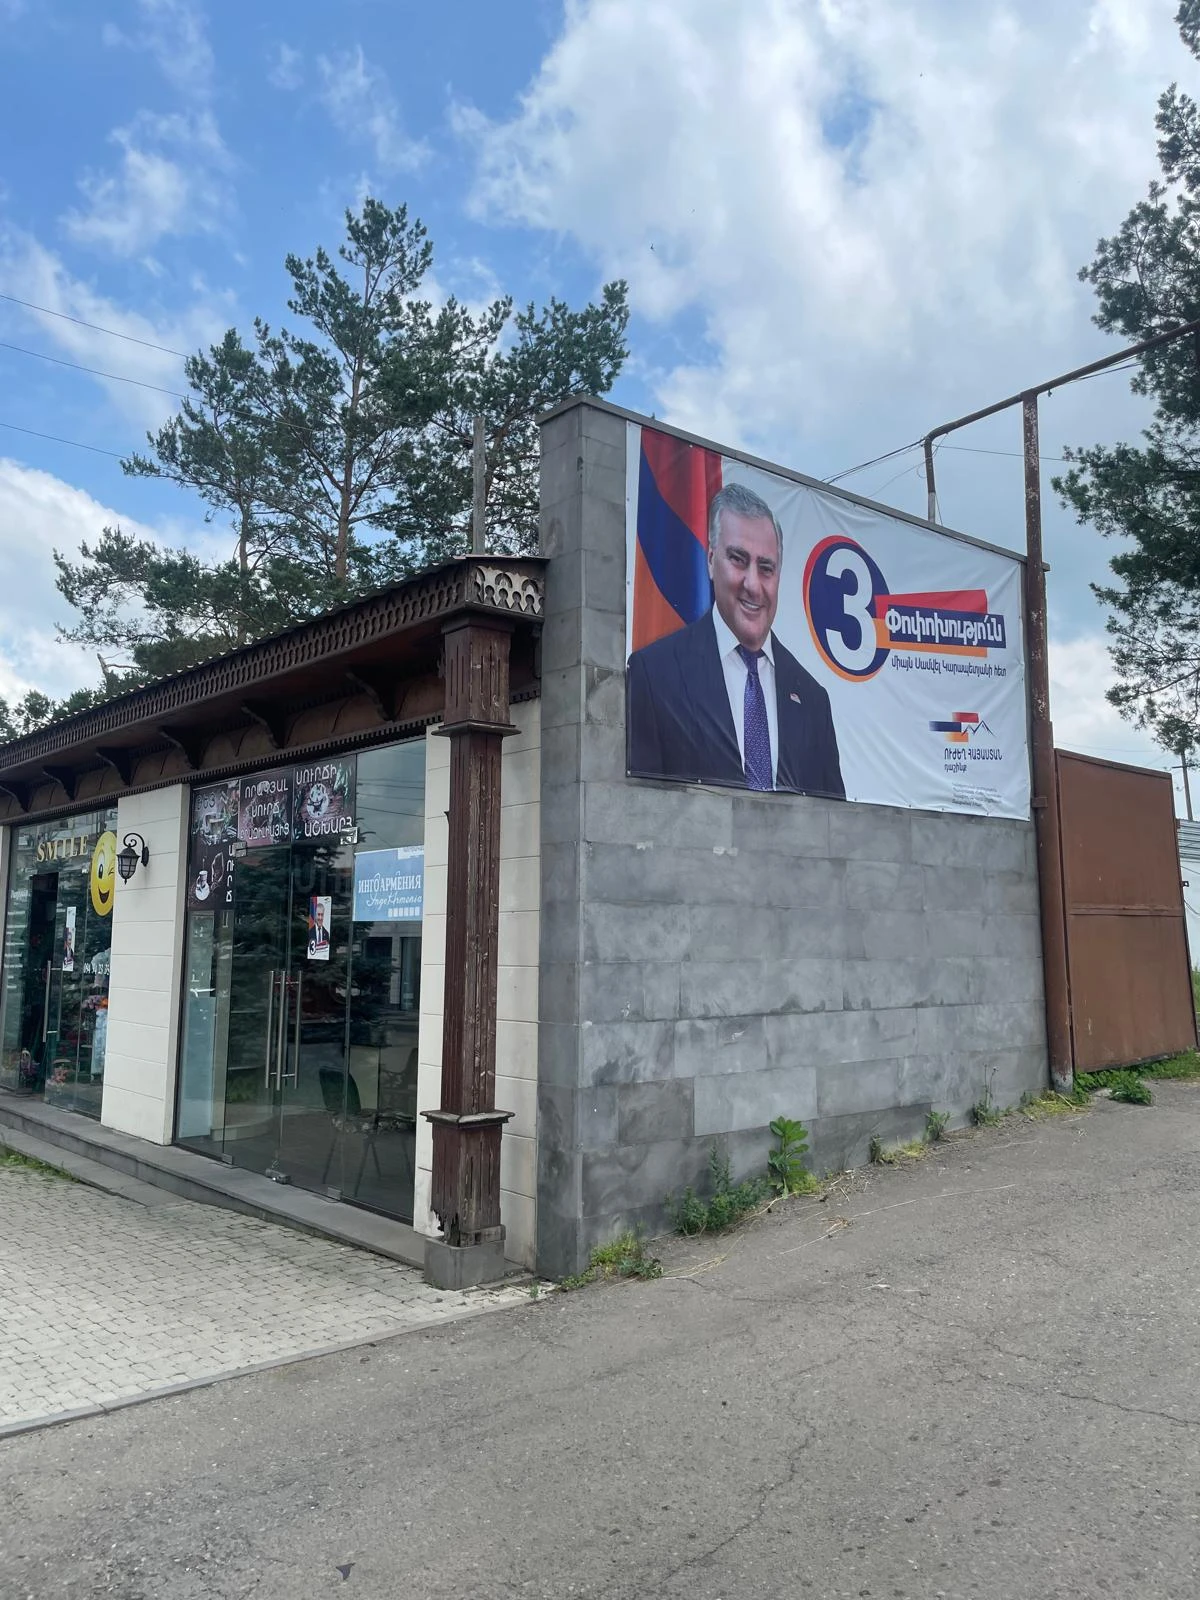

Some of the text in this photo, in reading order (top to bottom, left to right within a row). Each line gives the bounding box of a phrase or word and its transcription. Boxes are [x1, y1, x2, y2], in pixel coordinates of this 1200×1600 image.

[826, 548, 876, 671] 3
[915, 657, 941, 674] Սամվել
[942, 659, 993, 678] Կարապետյանի
[994, 664, 1007, 677] հետ
[944, 748, 1002, 761] ՈՒԺԵՂ ՀԱՅԱՍՏԱՆ
[944, 763, 967, 773] դաշինք
[245, 779, 289, 798] ՈՐԱԿՅԱԼ
[251, 801, 280, 817] ՍՈՒՐՃ
[36, 834, 89, 862] SMILE
